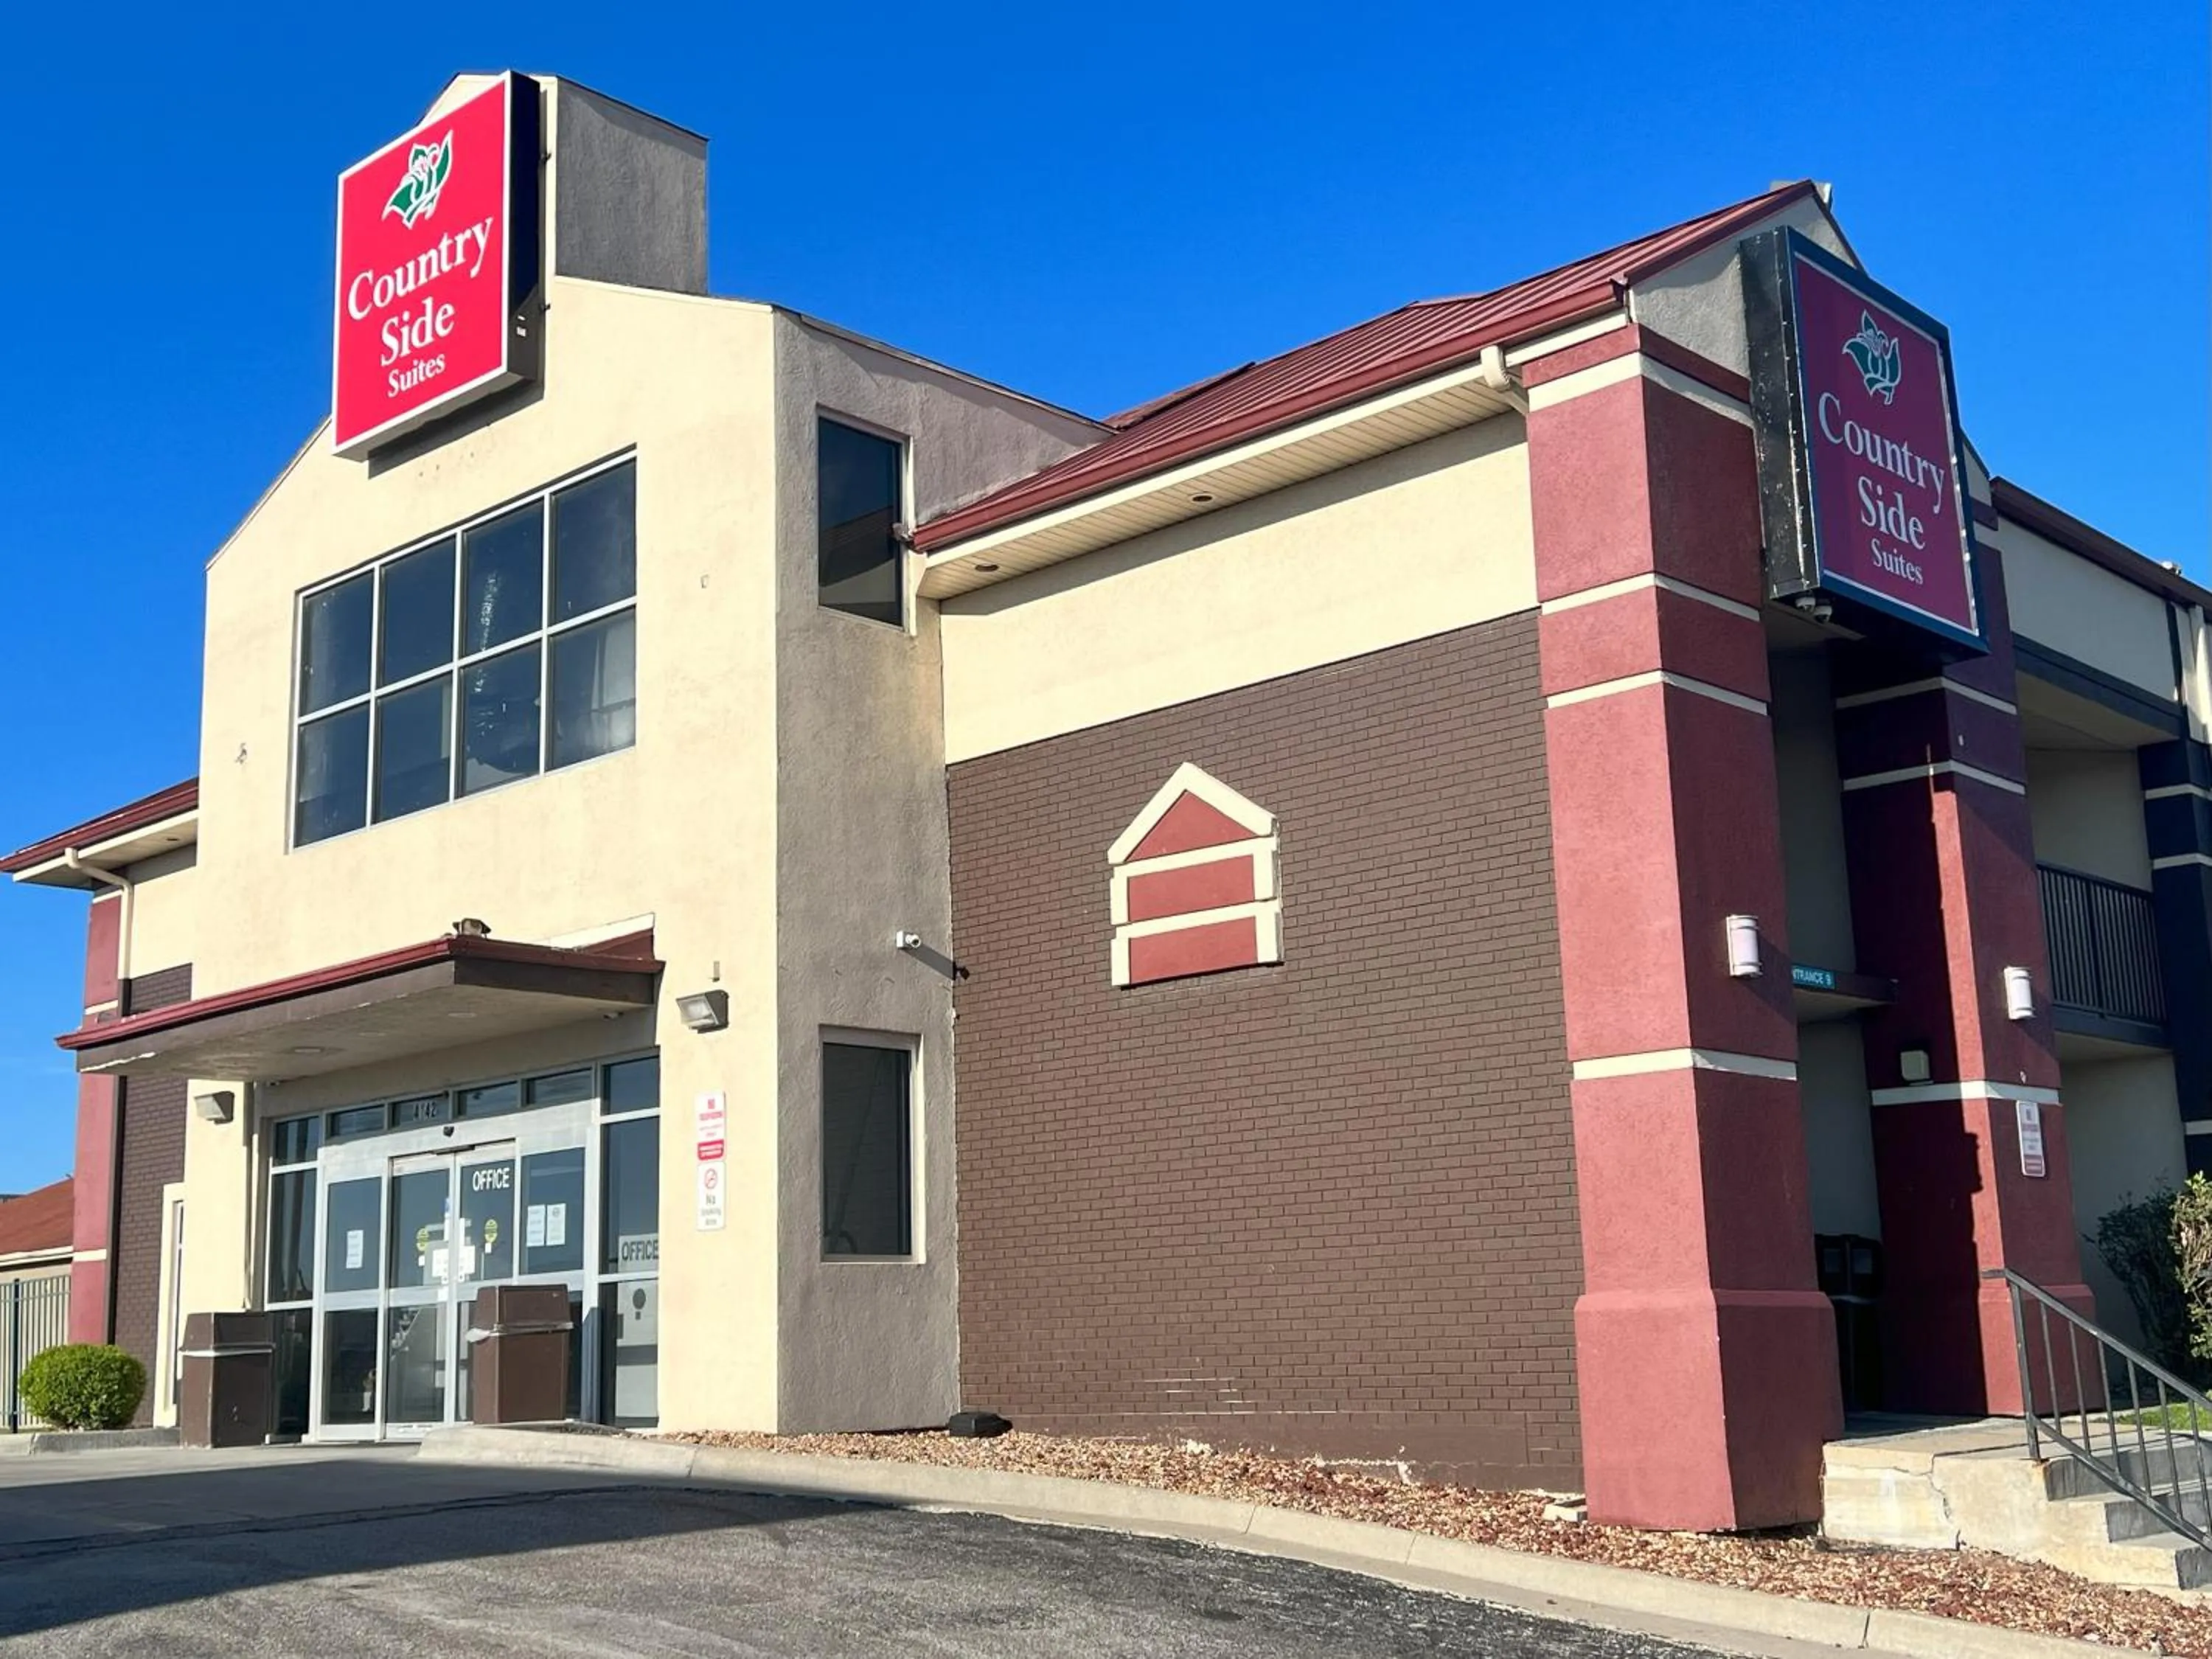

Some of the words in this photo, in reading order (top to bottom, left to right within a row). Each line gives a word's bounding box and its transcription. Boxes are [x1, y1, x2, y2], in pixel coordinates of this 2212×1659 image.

[348, 218, 493, 320] Country
[381, 297, 455, 366] Side
[389, 353, 445, 397] Suites
[1818, 392, 1944, 513] Country
[1858, 476, 1926, 550] Side
[1871, 538, 1922, 585] Suites
[473, 1167, 509, 1192] OFFICE
[622, 1239, 658, 1261] OFFICE
